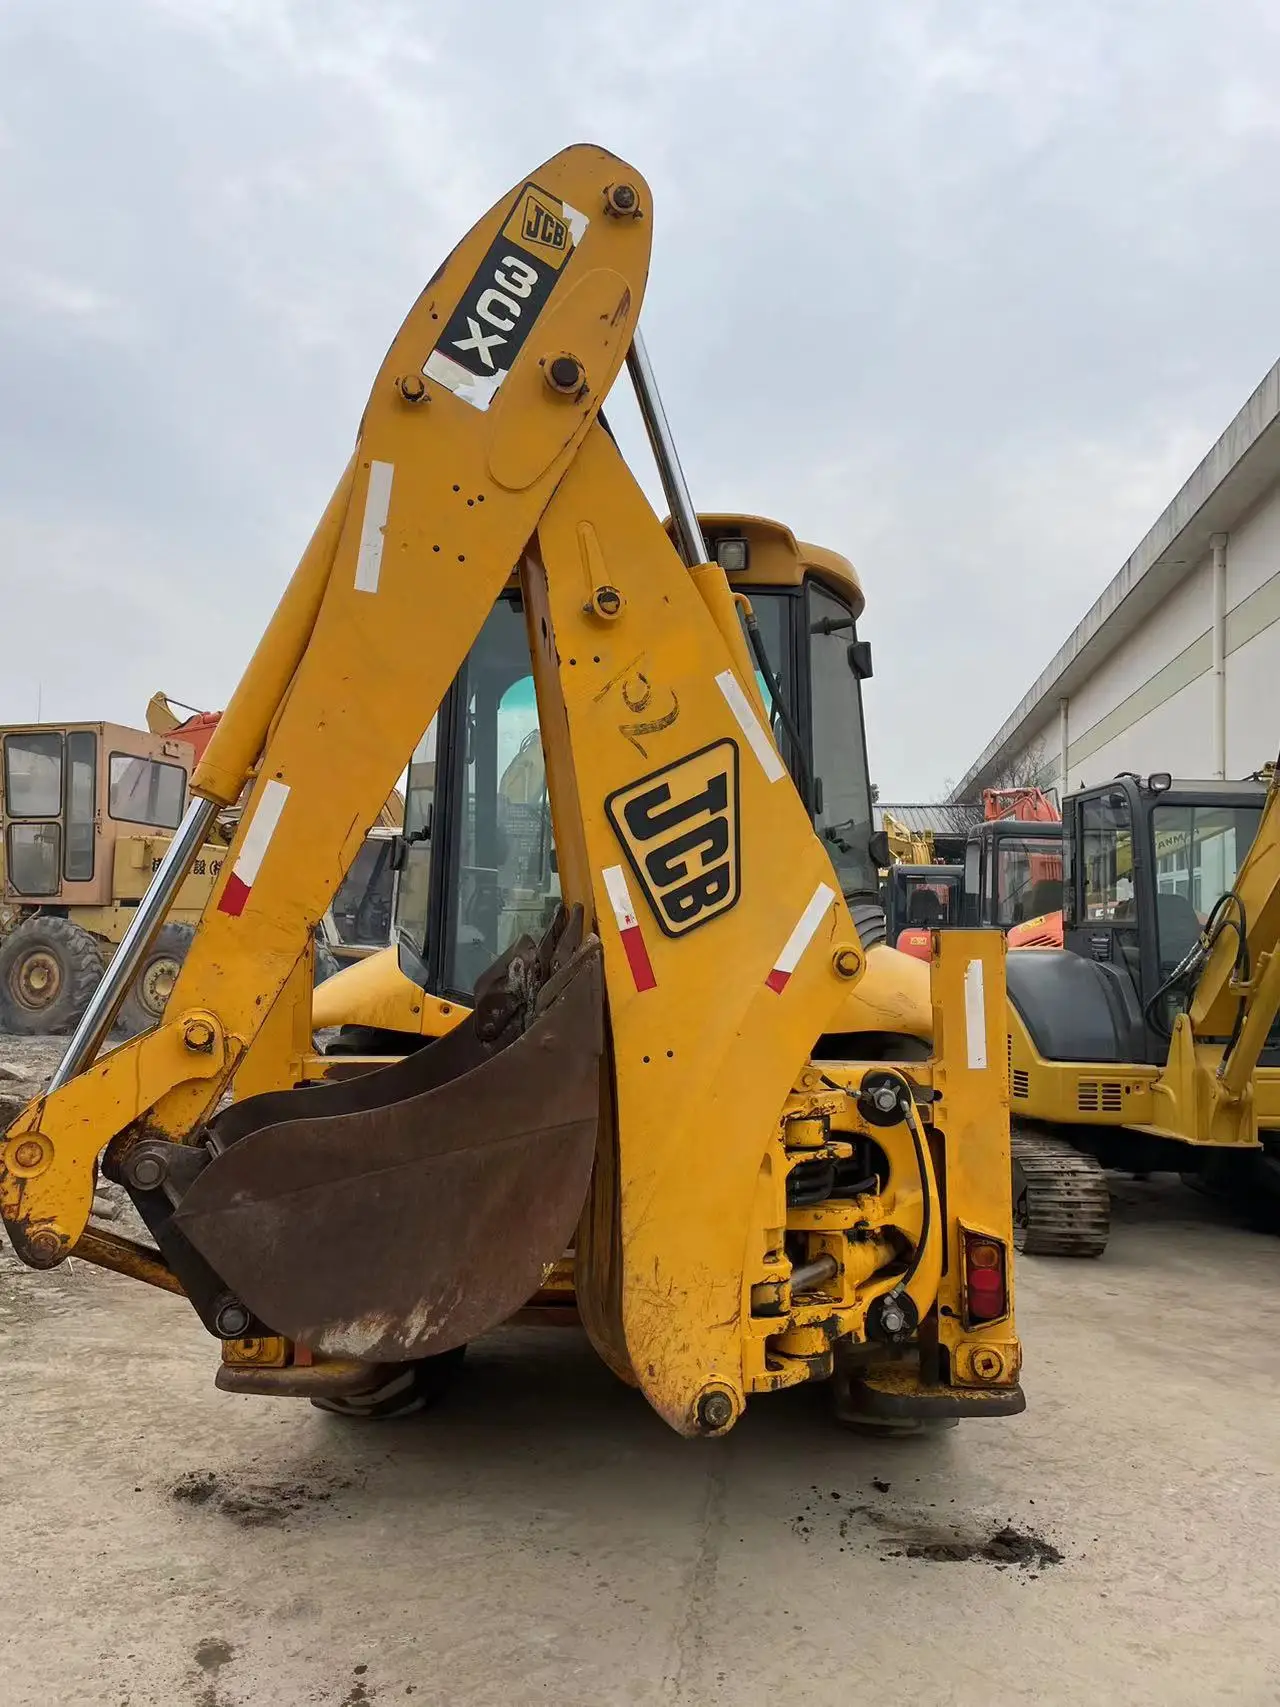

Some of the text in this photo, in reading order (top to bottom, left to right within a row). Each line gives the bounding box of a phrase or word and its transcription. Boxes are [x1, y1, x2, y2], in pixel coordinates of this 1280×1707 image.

[526, 204, 566, 247] JCB
[451, 255, 539, 369] 3CX
[623, 771, 731, 923] JCB
